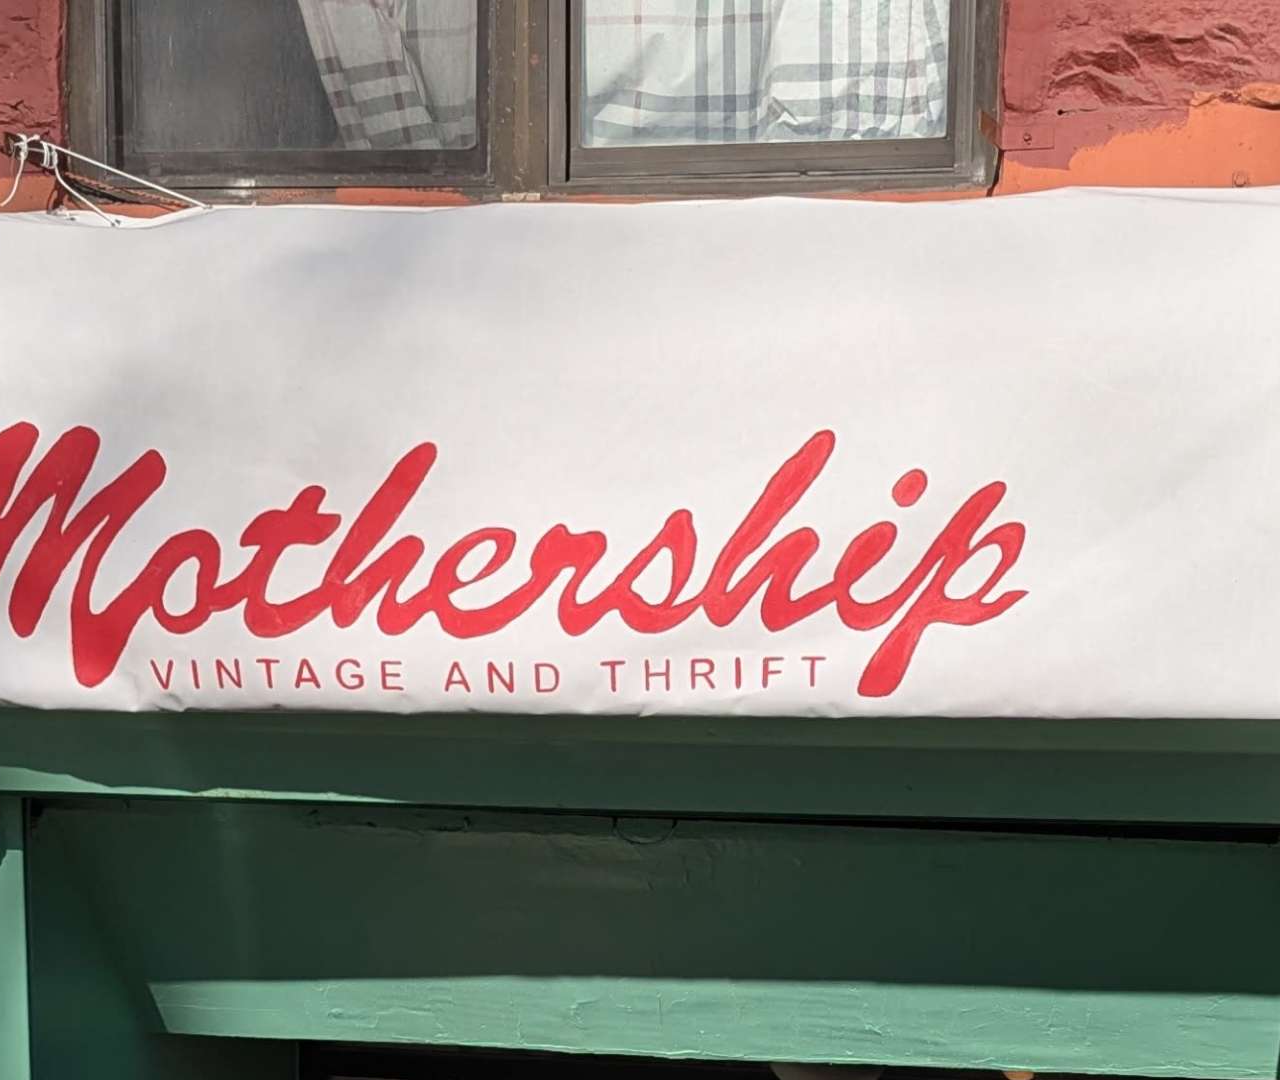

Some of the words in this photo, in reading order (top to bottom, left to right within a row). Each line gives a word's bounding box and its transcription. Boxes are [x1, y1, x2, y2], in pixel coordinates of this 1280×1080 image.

[151, 656, 406, 692] VINTAGE
[444, 659, 562, 694] AND
[600, 655, 827, 691] THRIFT
